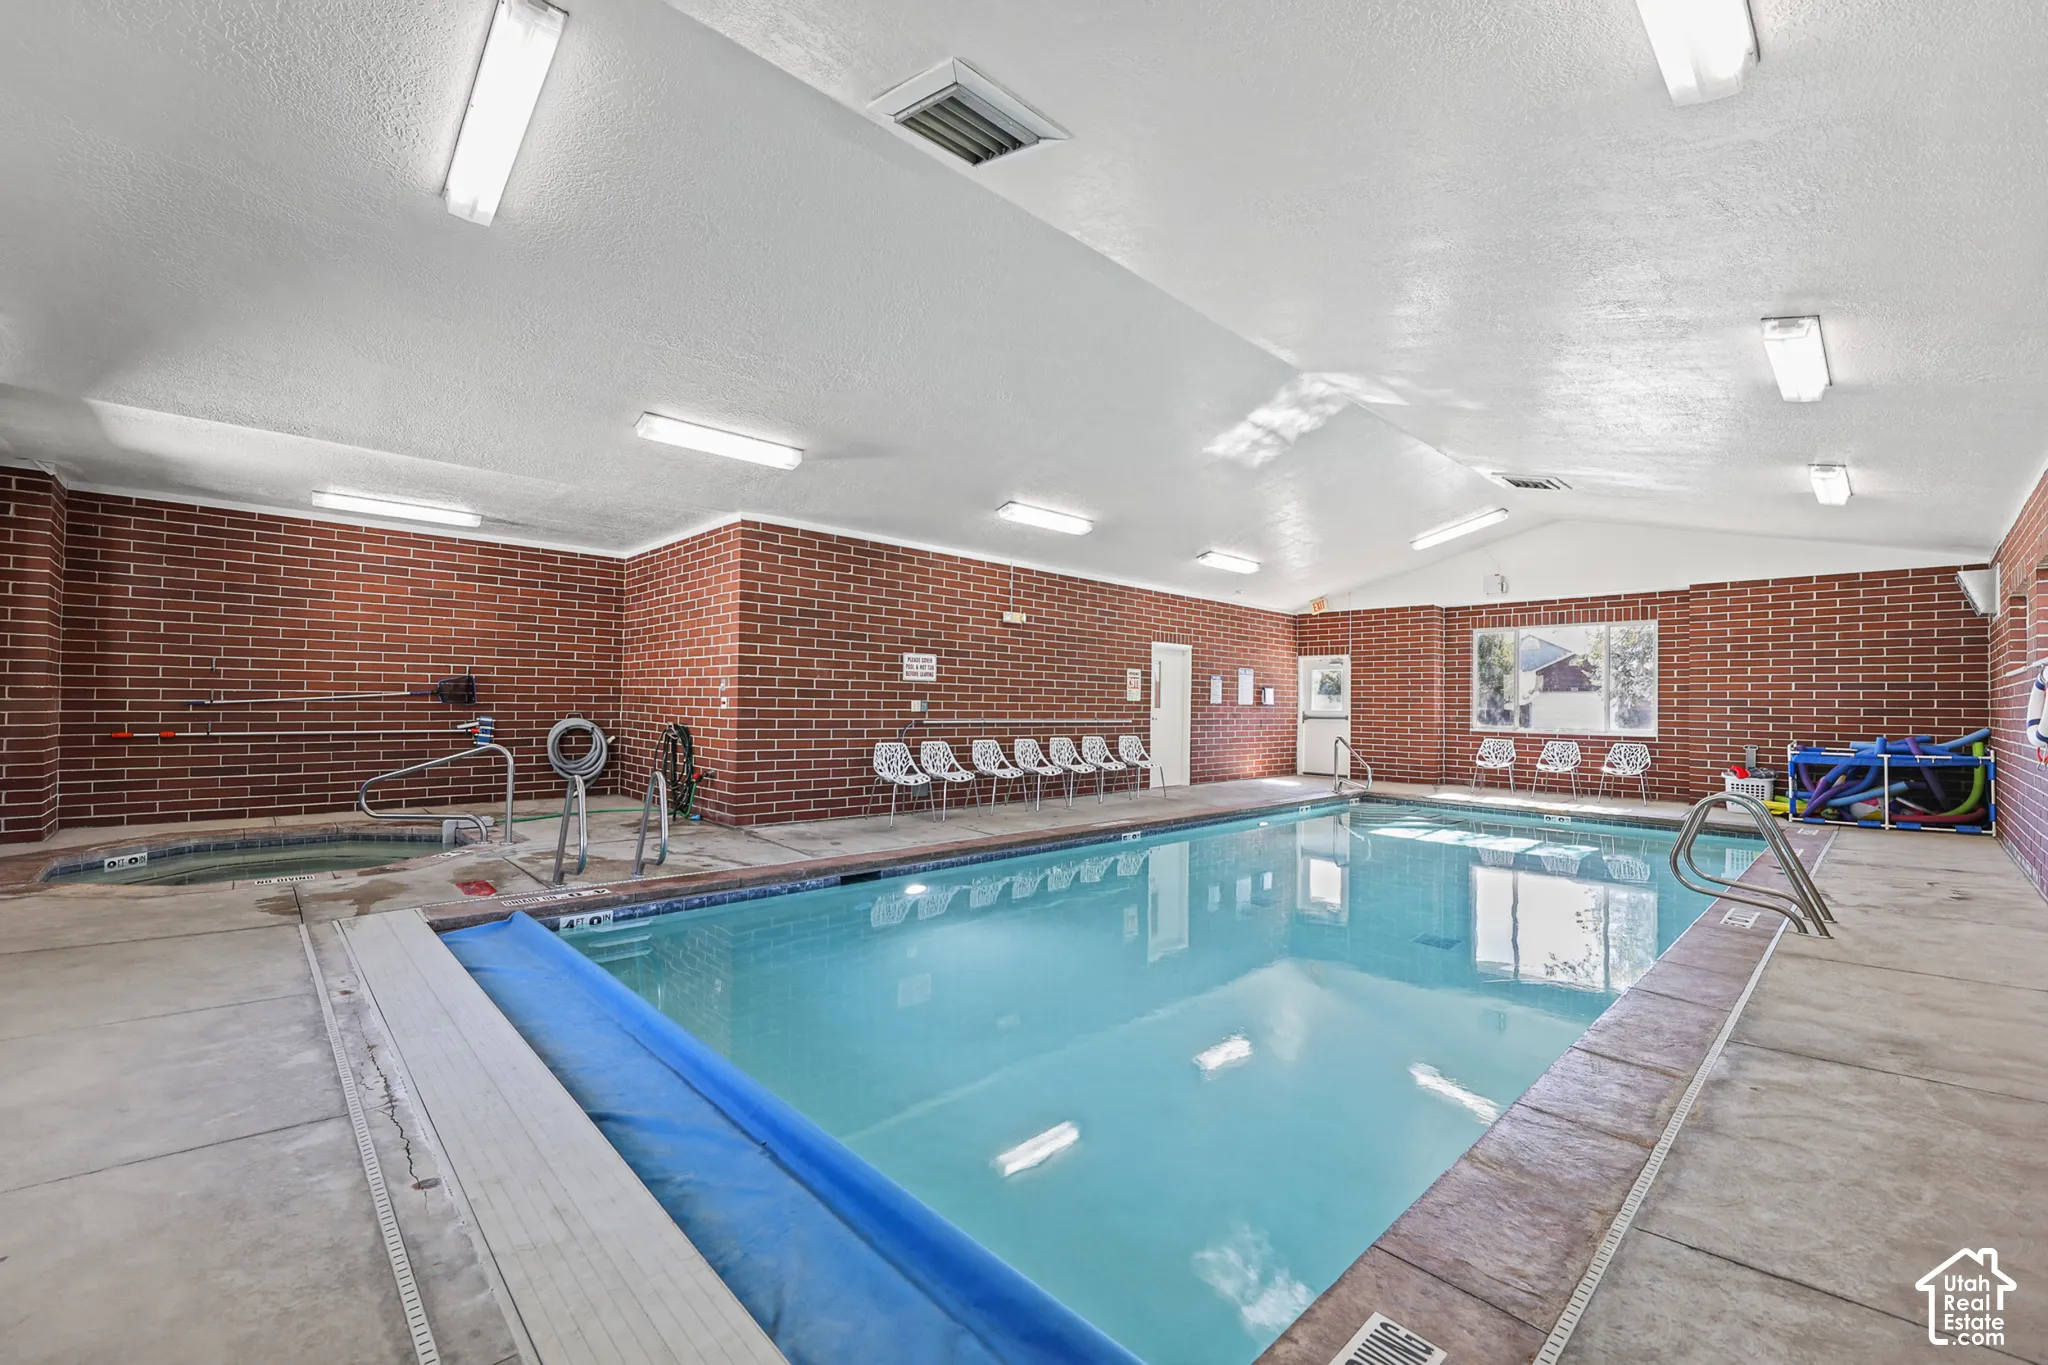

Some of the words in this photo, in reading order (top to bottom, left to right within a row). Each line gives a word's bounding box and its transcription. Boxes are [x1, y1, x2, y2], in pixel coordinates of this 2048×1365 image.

[1312, 600, 1325, 612] EXIT
[504, 897, 539, 906] DIVING
[1344, 1321, 1435, 1365] VING
